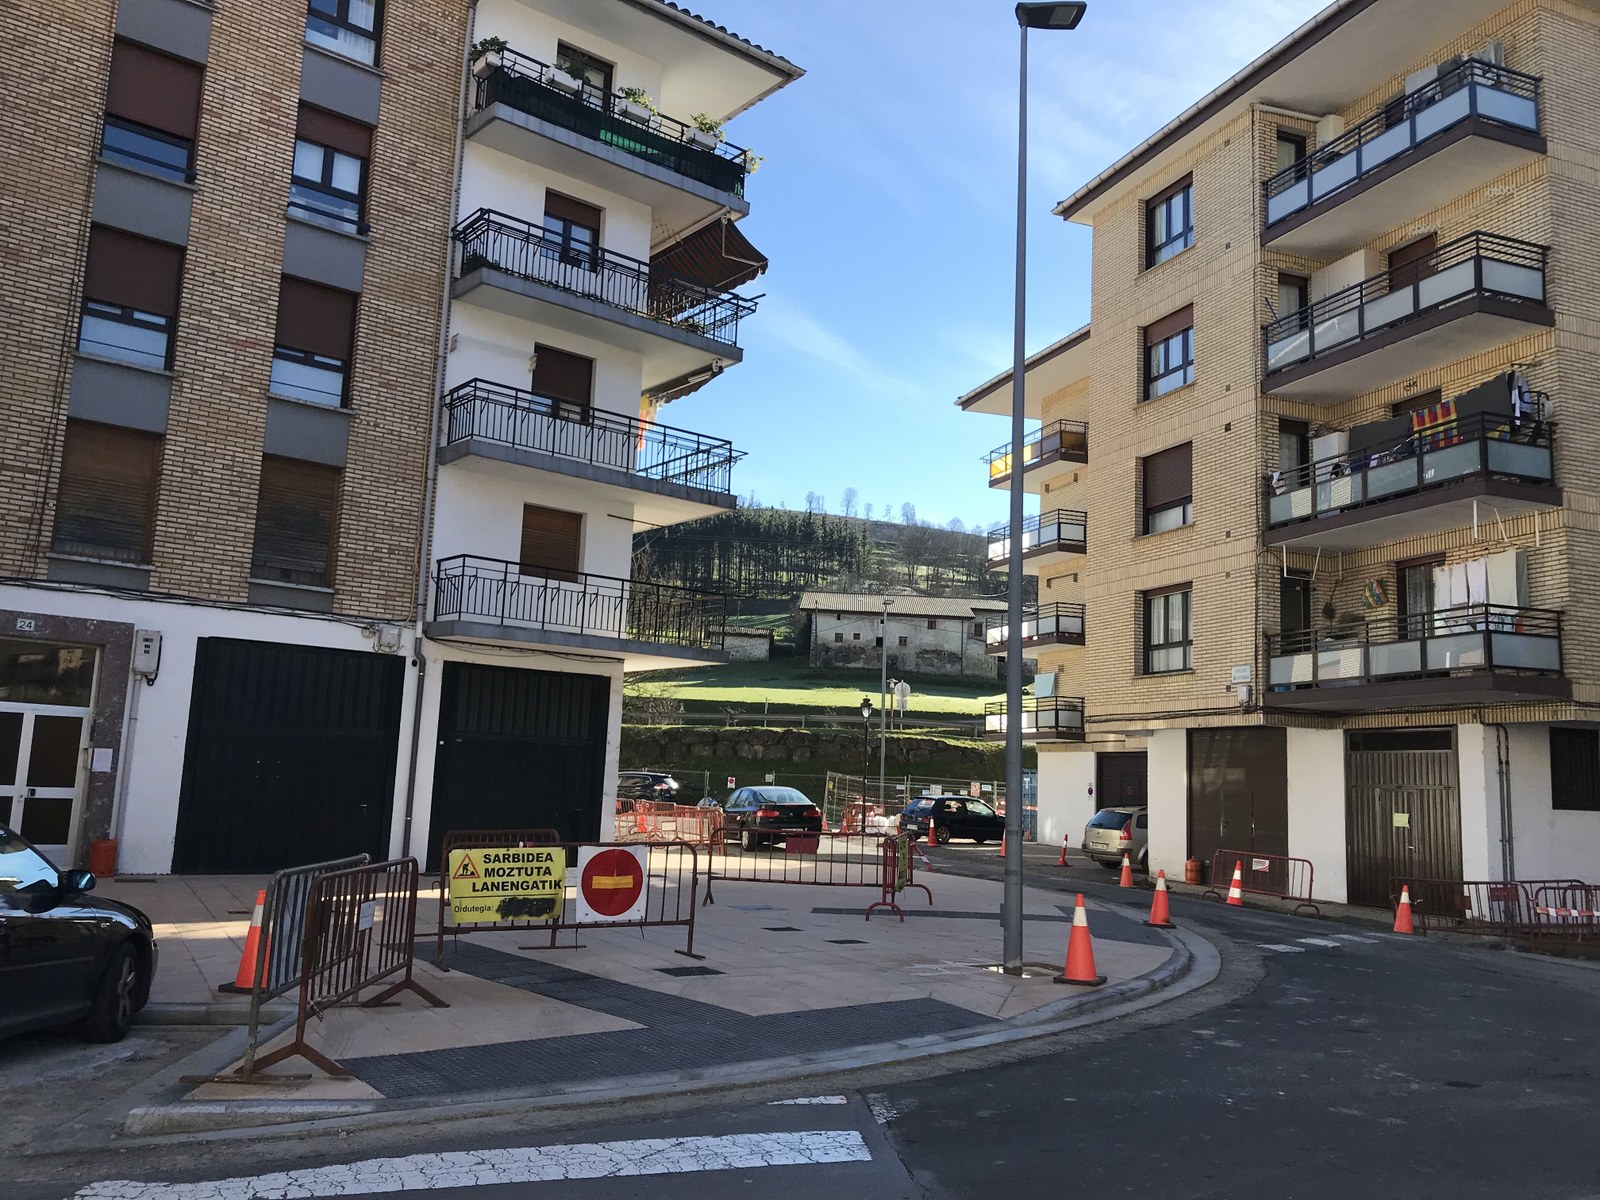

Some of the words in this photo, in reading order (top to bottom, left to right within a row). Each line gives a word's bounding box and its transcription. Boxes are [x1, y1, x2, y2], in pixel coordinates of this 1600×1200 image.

[19, 621, 32, 629] 24
[483, 853, 553, 864] SARBIDEA
[484, 866, 552, 878] MOZTUTA
[472, 879, 562, 892] LANENGATIK
[454, 904, 494, 914] Ordutegia:
